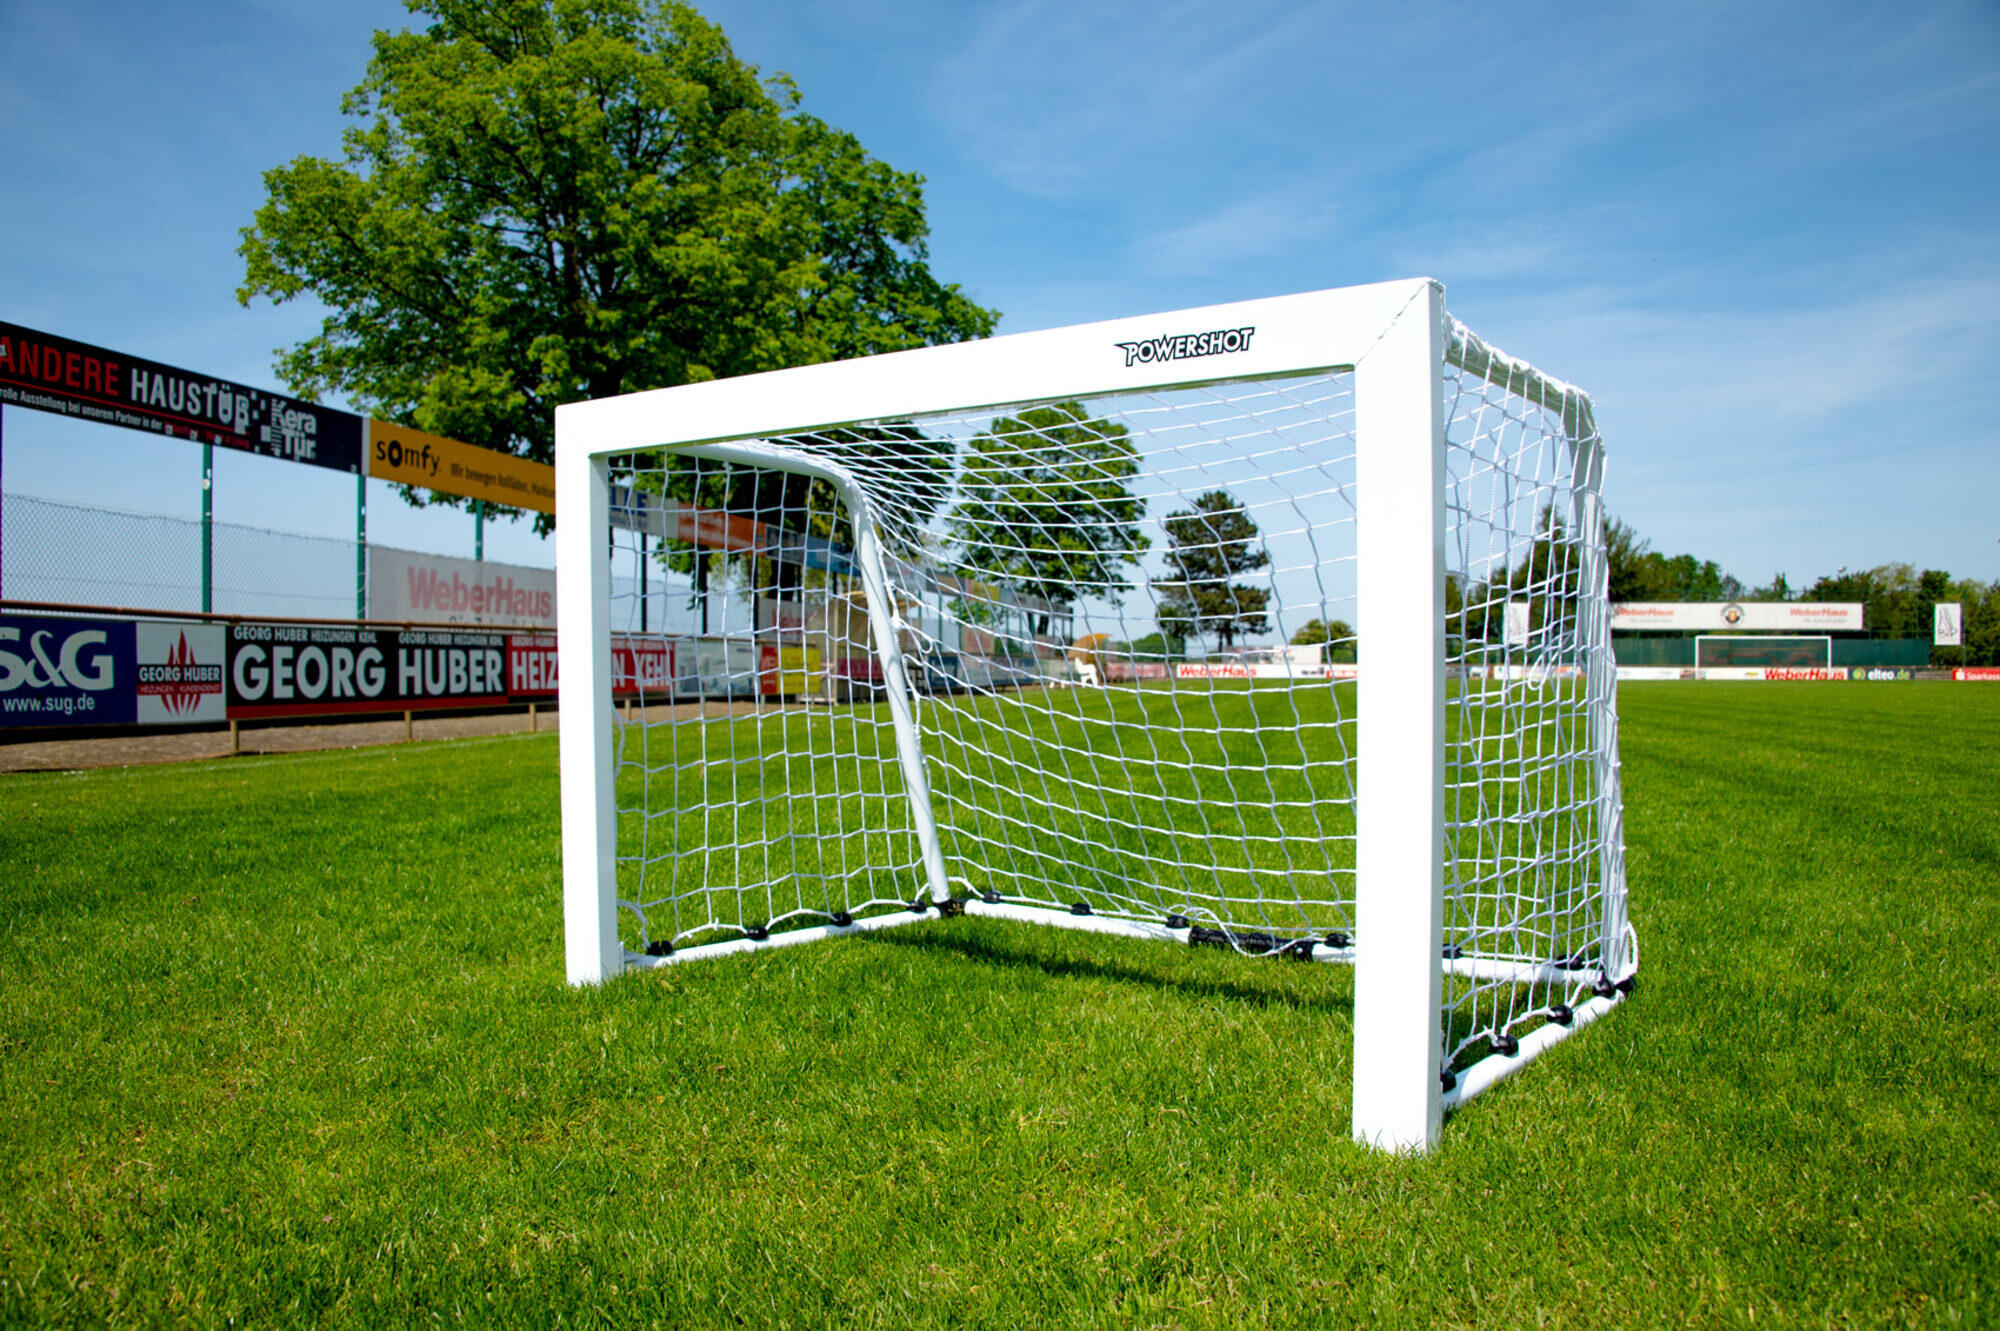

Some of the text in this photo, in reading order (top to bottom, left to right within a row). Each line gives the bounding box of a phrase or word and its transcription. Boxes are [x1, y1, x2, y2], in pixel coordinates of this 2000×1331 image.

[1114, 326, 1255, 367] POWERSHOT
[0, 335, 119, 396] ANDERE
[67, 400, 80, 413] bei
[81, 405, 114, 420] unserem
[376, 440, 440, 477] somfy
[407, 565, 553, 619] WeberHaus
[233, 626, 272, 641] GEORG
[275, 628, 309, 642] HUBER
[0, 626, 115, 691] S&G
[139, 666, 220, 682] GEORG HUBER
[233, 643, 503, 700] GEORG HUBER
[1179, 665, 1257, 678] WeberHaus
[1764, 669, 1845, 680] WeberHaus
[1868, 668, 1911, 680] elteo.de
[3, 692, 96, 715] www.sug.de
